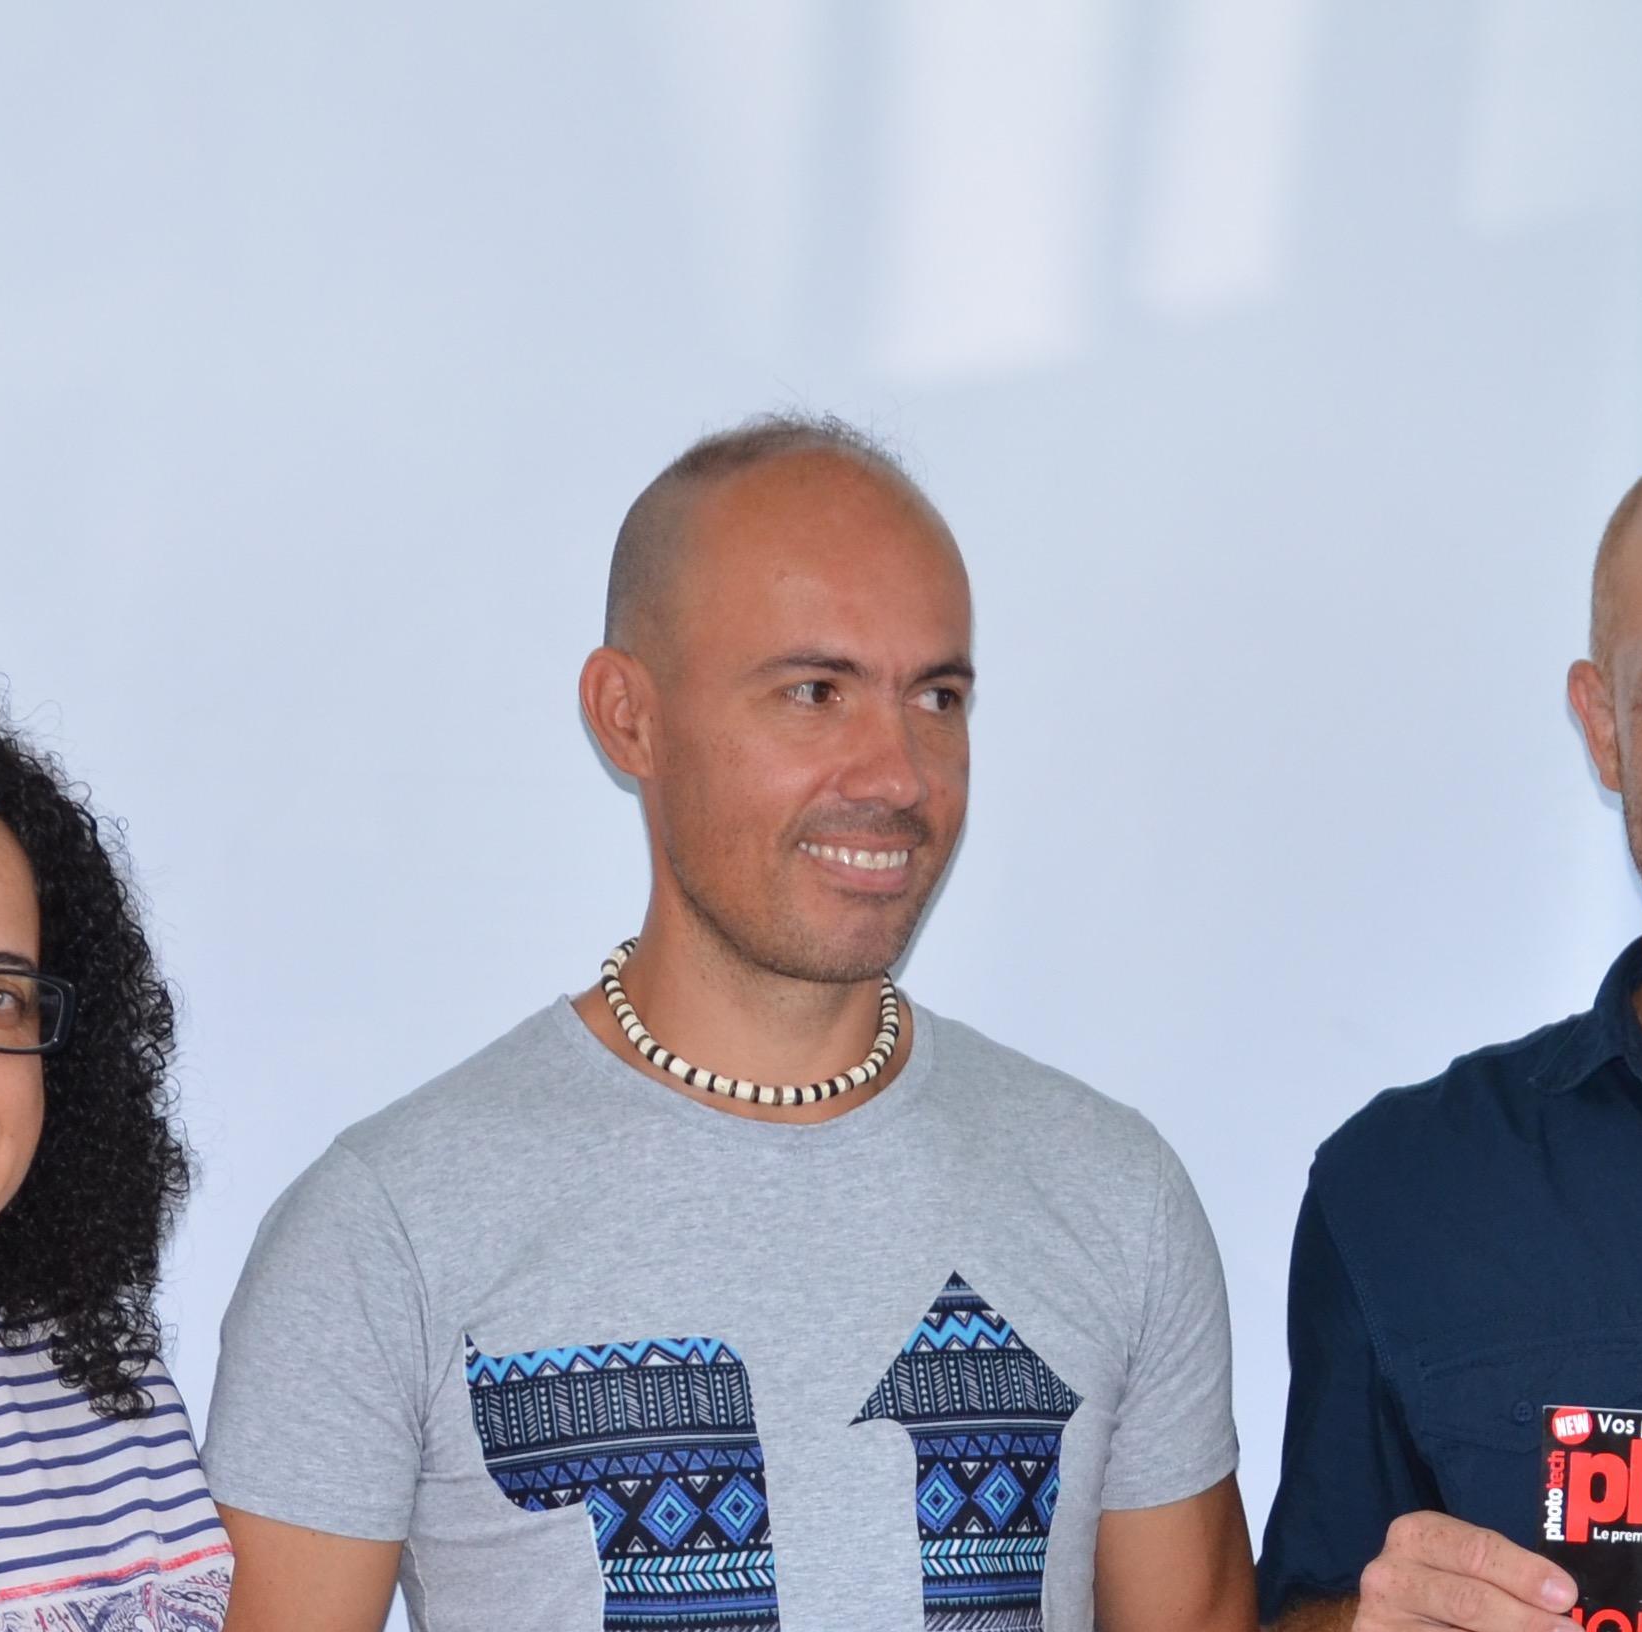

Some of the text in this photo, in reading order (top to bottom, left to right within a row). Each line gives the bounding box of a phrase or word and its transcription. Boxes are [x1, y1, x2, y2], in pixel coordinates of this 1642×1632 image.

[1555, 1413, 1590, 1437] NEW
[1598, 1414, 1635, 1434] Vos
[1593, 1527, 1609, 1540] Le
